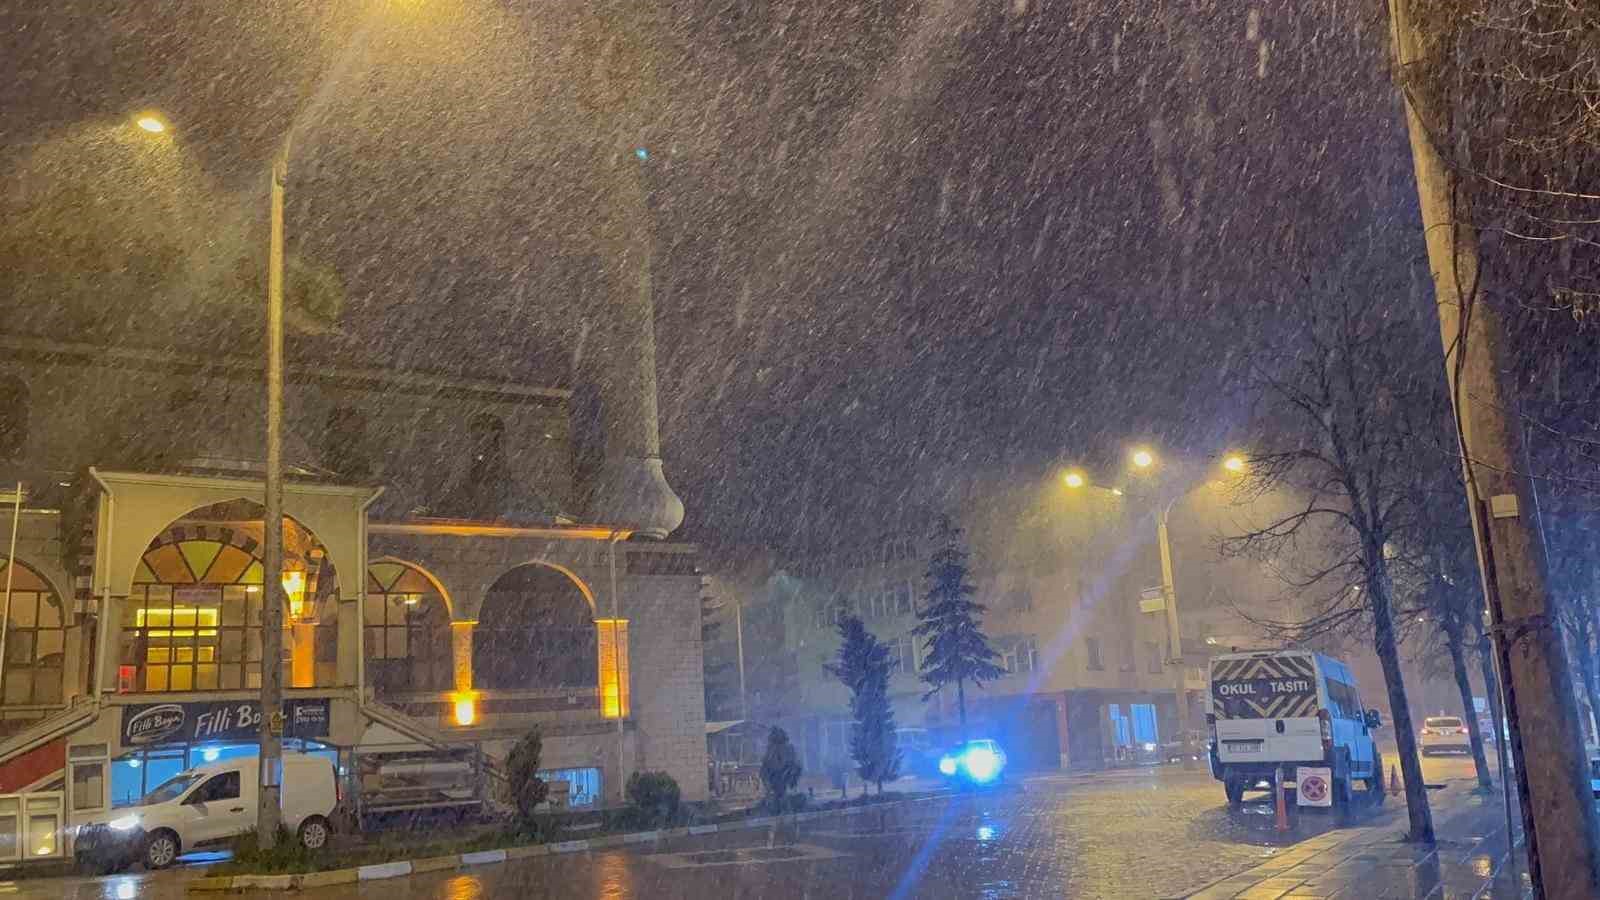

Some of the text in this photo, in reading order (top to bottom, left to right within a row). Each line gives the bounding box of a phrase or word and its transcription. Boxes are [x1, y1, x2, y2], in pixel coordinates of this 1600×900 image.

[1220, 684, 1256, 695] OKUL
[195, 705, 287, 738] Filli Bo
